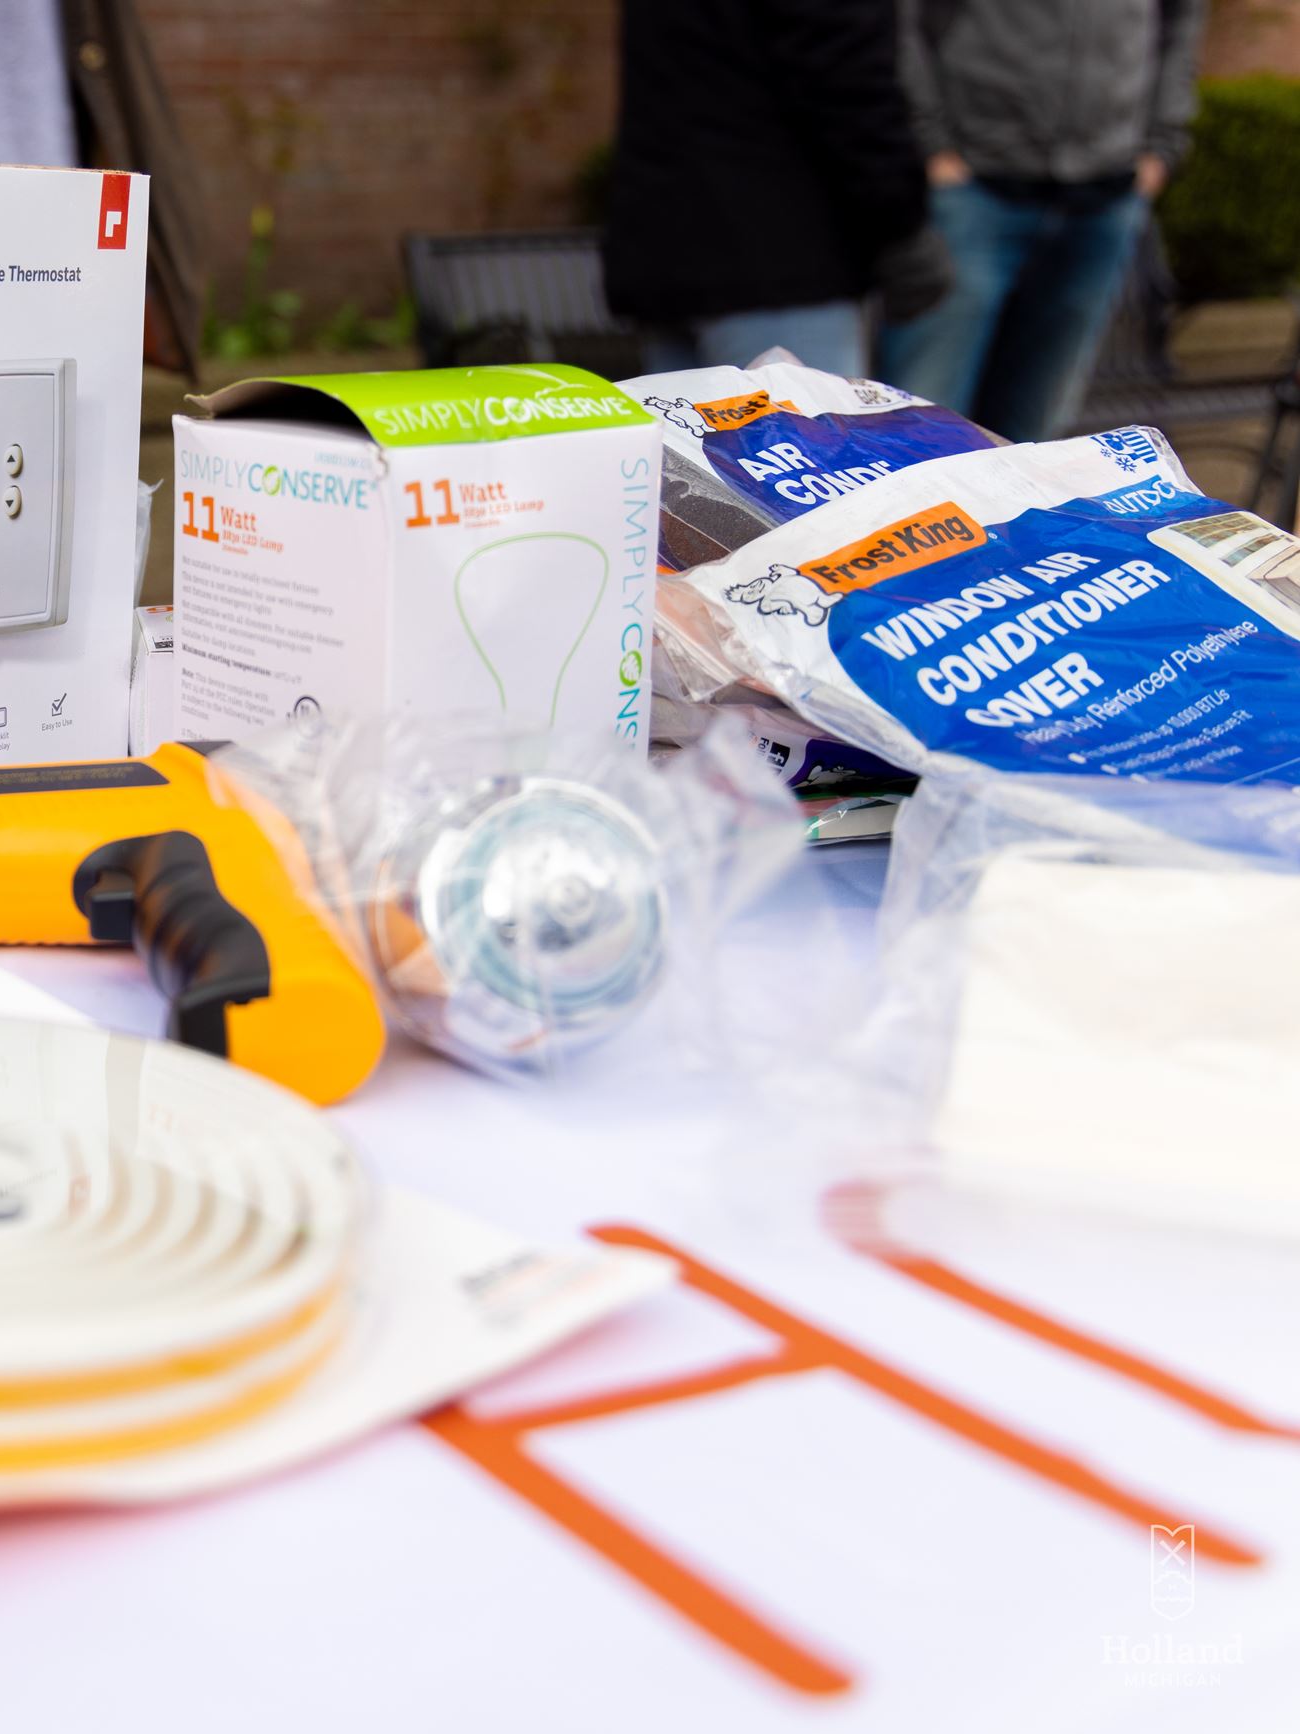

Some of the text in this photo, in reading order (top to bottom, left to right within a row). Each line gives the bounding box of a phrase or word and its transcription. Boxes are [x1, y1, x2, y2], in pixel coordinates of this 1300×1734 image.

[8, 265, 82, 283] Thermostat
[373, 395, 632, 436] SIMPLYCONSERVE
[701, 398, 762, 424] Frost
[180, 450, 370, 510] SIMPLYCONSERVE
[736, 442, 817, 482] AIR
[182, 490, 257, 543] 11 Watt
[404, 478, 507, 528] 11 Watt
[513, 499, 545, 514] Lamp
[260, 535, 284, 554] Lamp
[811, 515, 976, 584] Frost King
[860, 551, 1101, 661] WINDOW AIR
[916, 559, 1172, 706] CONDITIONER
[964, 651, 1105, 728] COVER
[1087, 659, 1178, 722] Reinforced
[1170, 619, 1260, 672] Polyethylene
[1196, 688, 1231, 714] BTUs
[41, 718, 73, 732] Easy to Use
